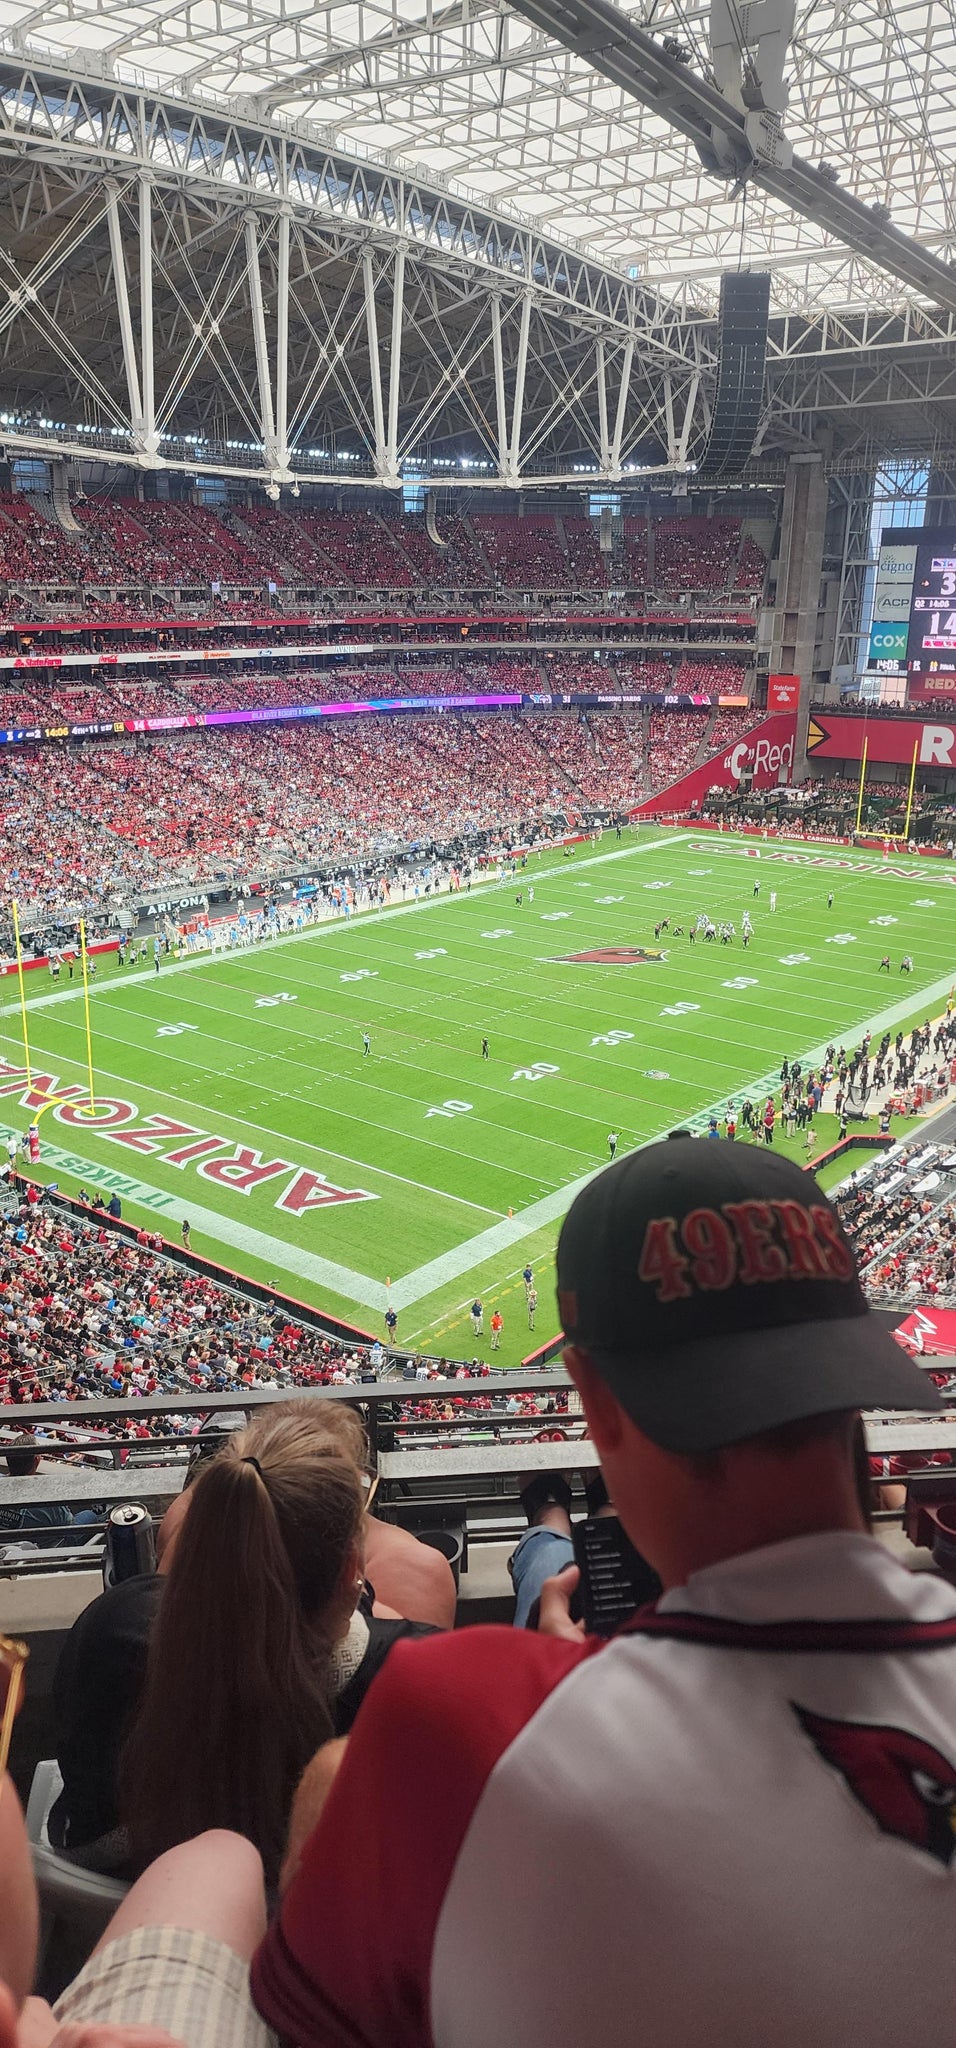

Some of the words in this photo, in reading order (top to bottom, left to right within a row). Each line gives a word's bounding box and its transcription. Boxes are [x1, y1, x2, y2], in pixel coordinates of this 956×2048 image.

[881, 561, 913, 574] cigna
[941, 572, 955, 595] 3
[873, 635, 905, 647] COX
[925, 678, 956, 690] RED
[806, 835, 844, 844] CARDINALS
[720, 976, 759, 990] 50
[662, 1001, 701, 1016] 40
[591, 1030, 635, 1046] 30
[513, 1062, 560, 1081] 20
[427, 1100, 473, 1118] 10
[638, 1199, 854, 1302] 49ERS
